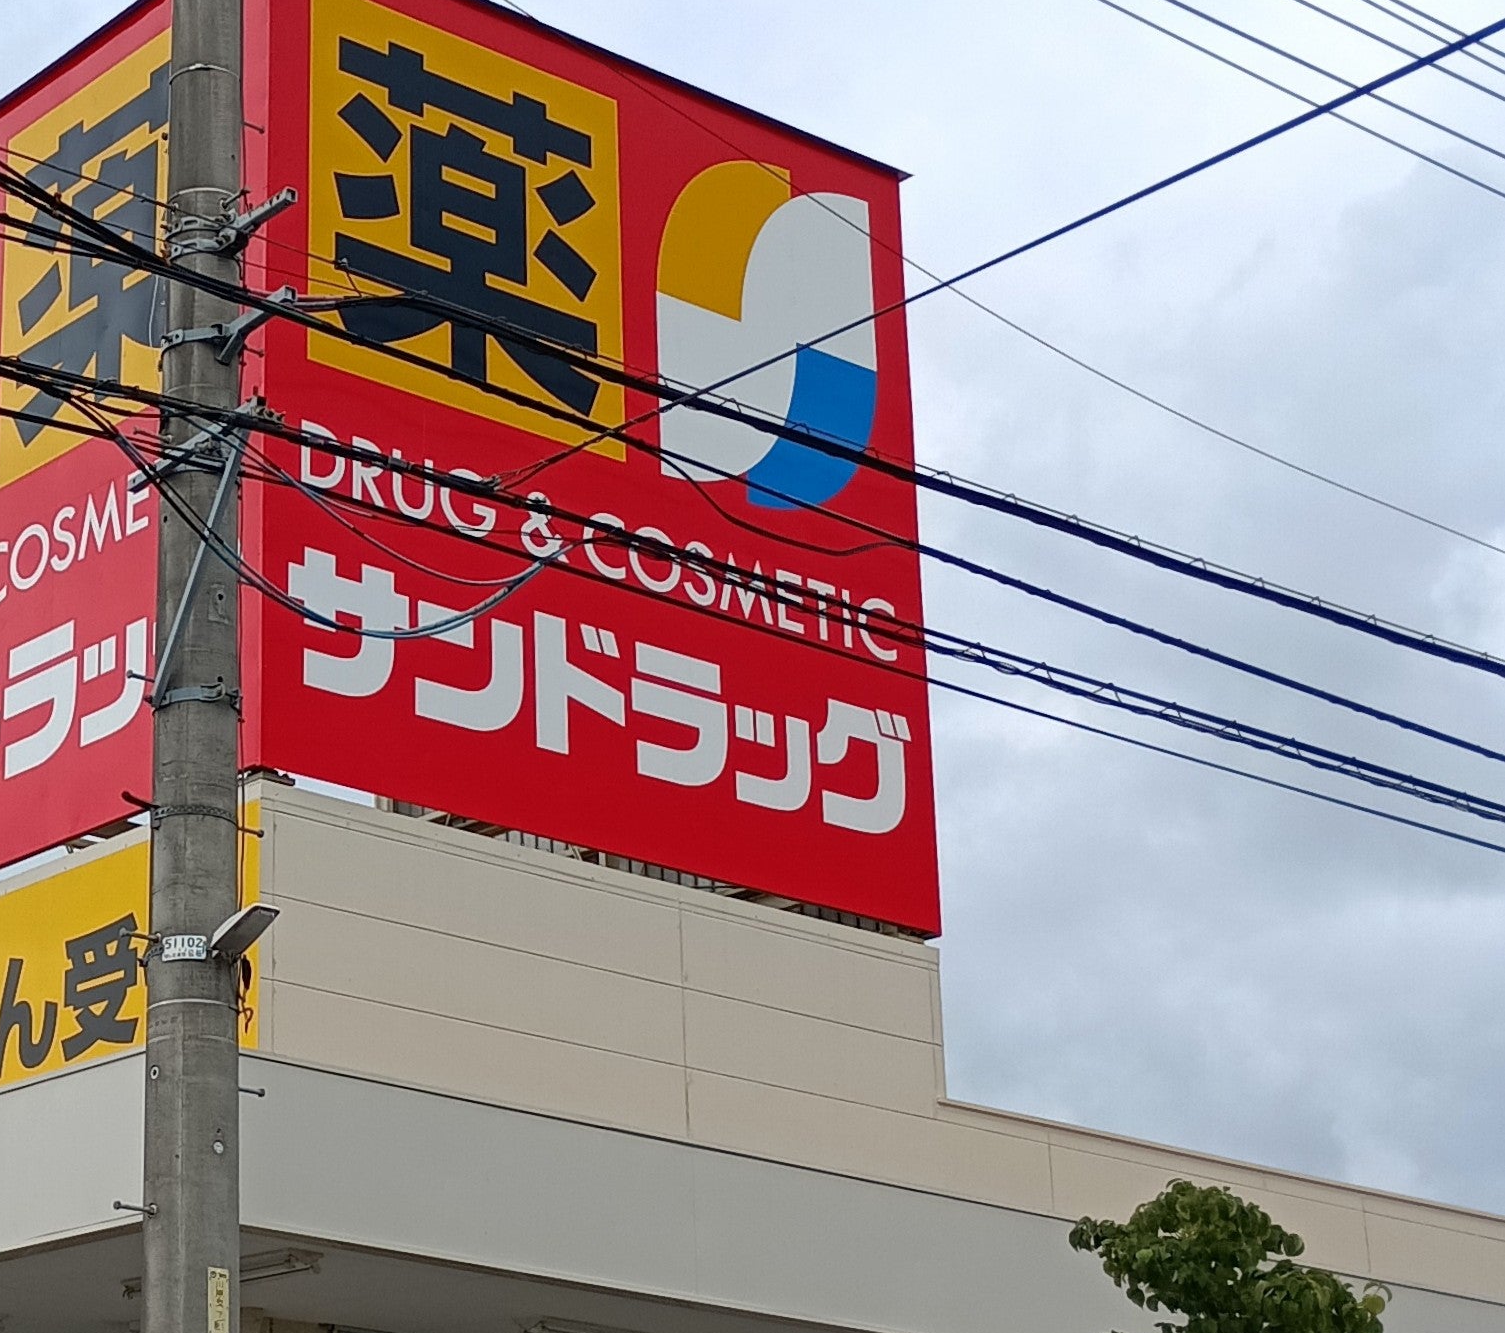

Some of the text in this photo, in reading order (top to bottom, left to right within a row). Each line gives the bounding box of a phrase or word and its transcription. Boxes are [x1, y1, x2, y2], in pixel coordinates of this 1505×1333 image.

[333, 34, 597, 416] 薬
[300, 418, 898, 662] DRUG & COSMETIC
[287, 546, 912, 835] サンドラッグ
